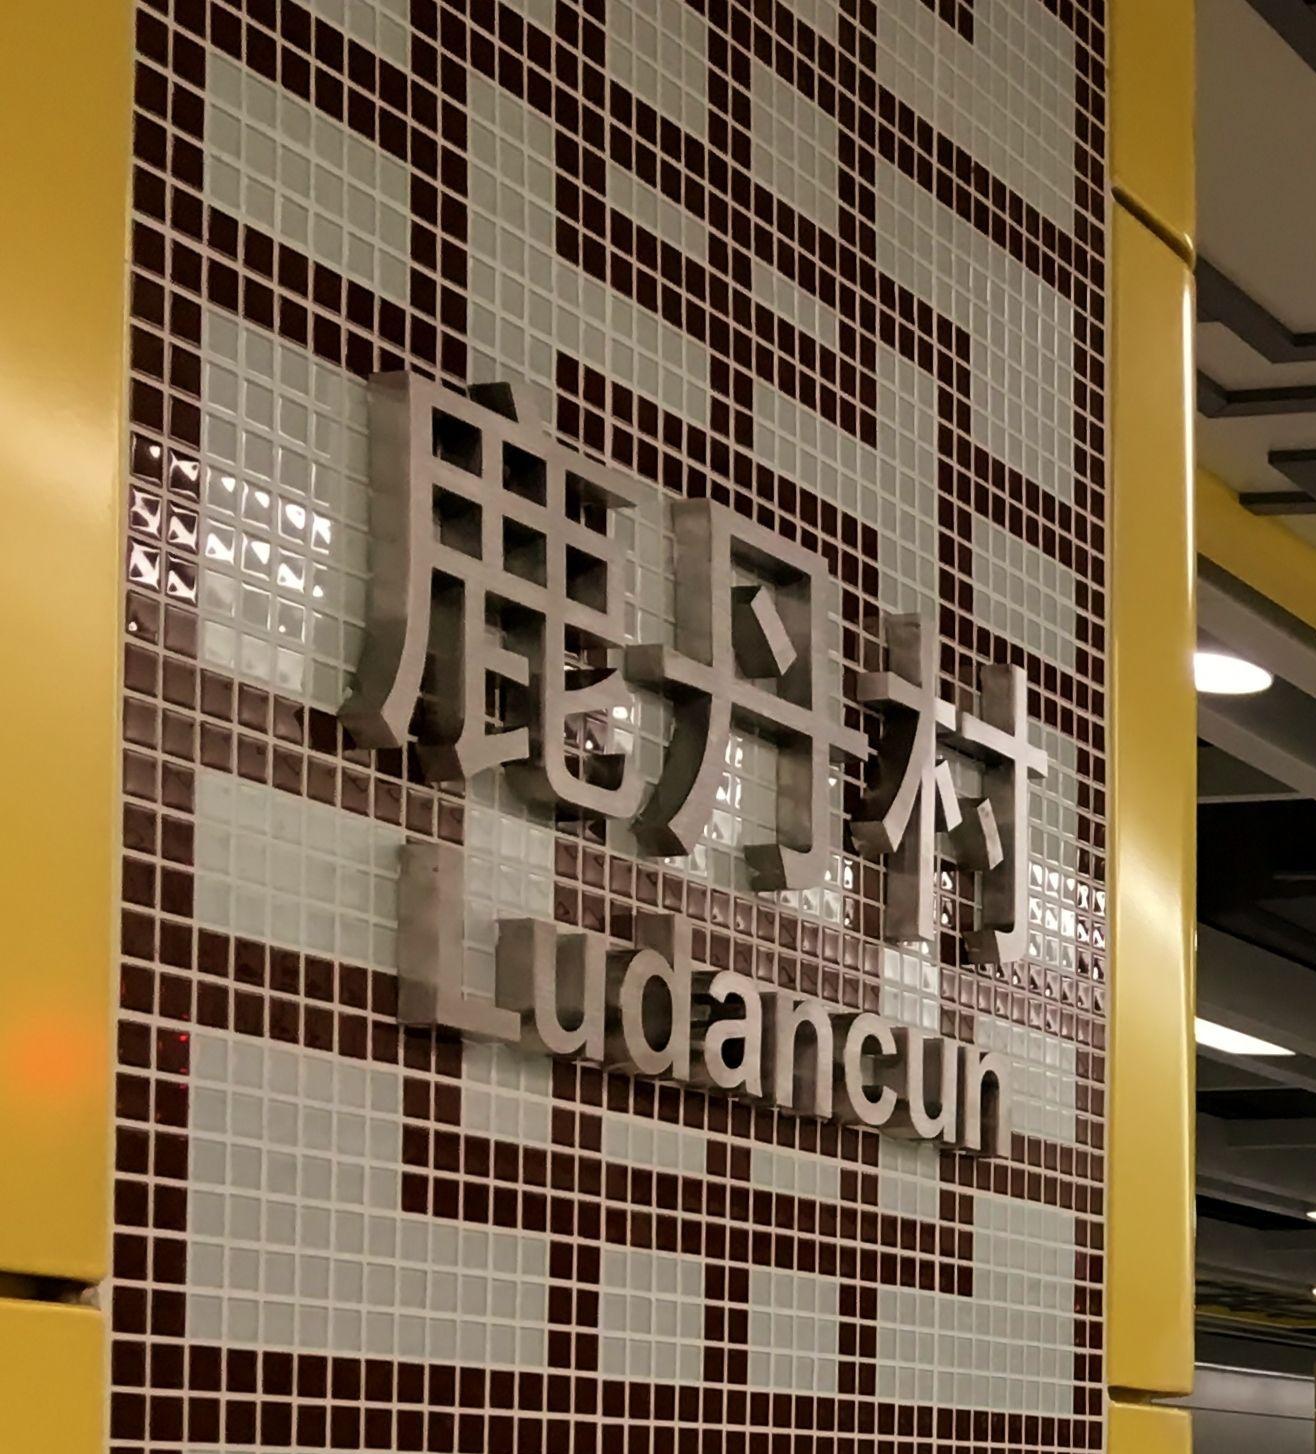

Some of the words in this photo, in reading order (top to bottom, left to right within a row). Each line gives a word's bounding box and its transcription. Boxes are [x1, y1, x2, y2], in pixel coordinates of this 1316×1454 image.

[340, 372, 1047, 965] 鹿丹村
[399, 840, 1011, 1155] Ludancun
